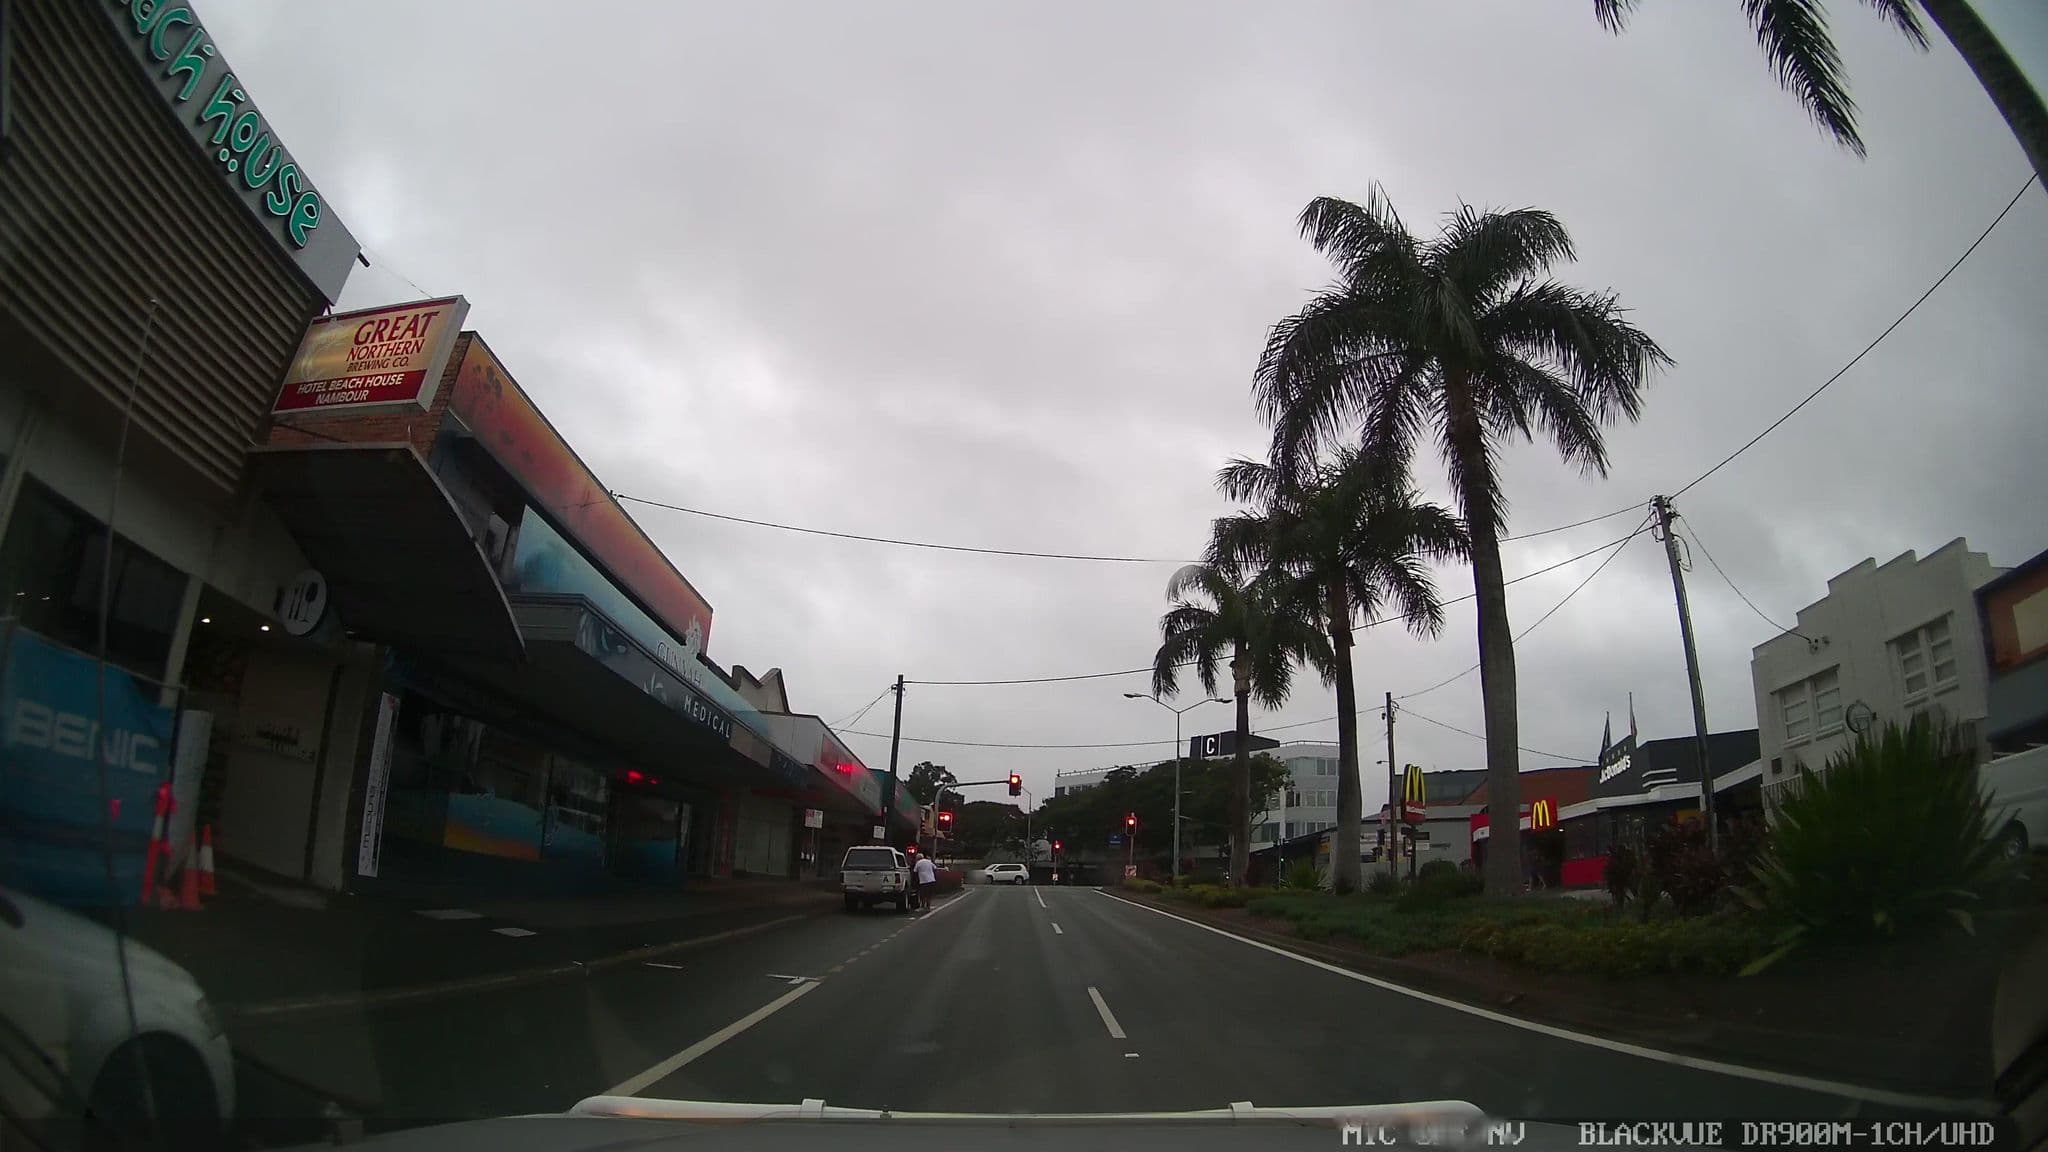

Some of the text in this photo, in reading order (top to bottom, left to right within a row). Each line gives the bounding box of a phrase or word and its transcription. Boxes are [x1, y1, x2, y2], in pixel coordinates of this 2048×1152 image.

[121, 0, 216, 101] ach
[354, 311, 440, 345] GREAT
[346, 339, 426, 362] NORTHERN
[346, 356, 409, 373] BREWING CO.
[297, 374, 405, 394] HOTEL BEACH HOUSE
[316, 390, 369, 405] NAMBOUR
[683, 695, 731, 738] MEDICAL
[1206, 737, 1215, 754] C
